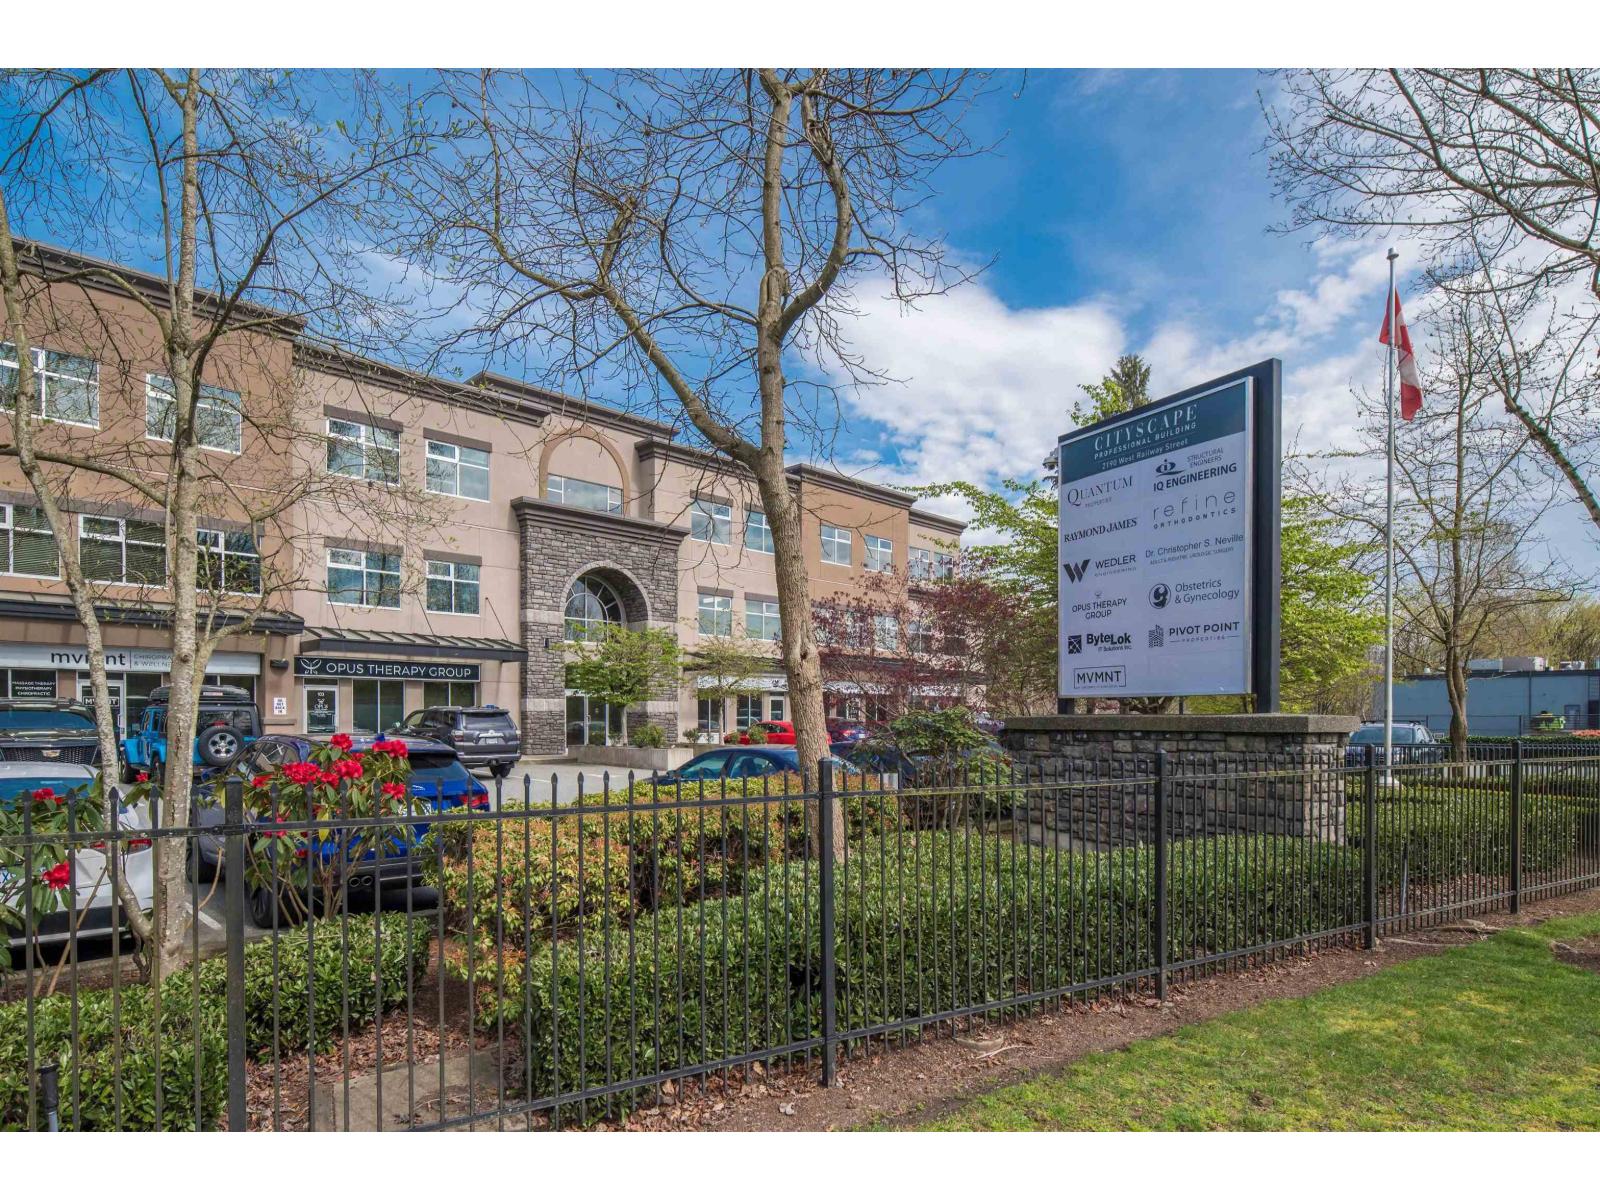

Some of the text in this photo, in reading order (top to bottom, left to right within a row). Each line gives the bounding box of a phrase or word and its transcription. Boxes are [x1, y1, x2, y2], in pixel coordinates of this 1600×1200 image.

[1094, 404, 1197, 451] CITYSCAPE
[1094, 421, 1197, 460] PROFESSIONAL BUILDING
[1102, 438, 1189, 470] 2190 West Railway Street
[1187, 448, 1224, 461] STRUCTURAL
[1189, 455, 1222, 467] ENGINEERS
[1153, 462, 1237, 492] IQ ENGINEERING
[1067, 475, 1133, 506] QUANTUM
[1153, 491, 1236, 520] refine
[1153, 507, 1236, 529] ORTHODONTICS
[1064, 517, 1138, 542] RAYMOND JAMES
[1157, 541, 1202, 556] Christopher
[1215, 534, 1243, 545] Neville
[1095, 554, 1136, 569] WEDLER
[1175, 579, 1222, 592] Obstetrics
[1174, 588, 1240, 604] & Gynecology
[1072, 597, 1127, 613] OPUS THERAPY
[1085, 609, 1112, 620] GROUP
[1168, 621, 1240, 636] PIVOT POINT
[1086, 632, 1131, 646] ByteLok
[51, 652, 126, 666] mvnt
[326, 662, 471, 678] OPUS THERAPY GROUP
[1077, 671, 1121, 684] MVMNT
